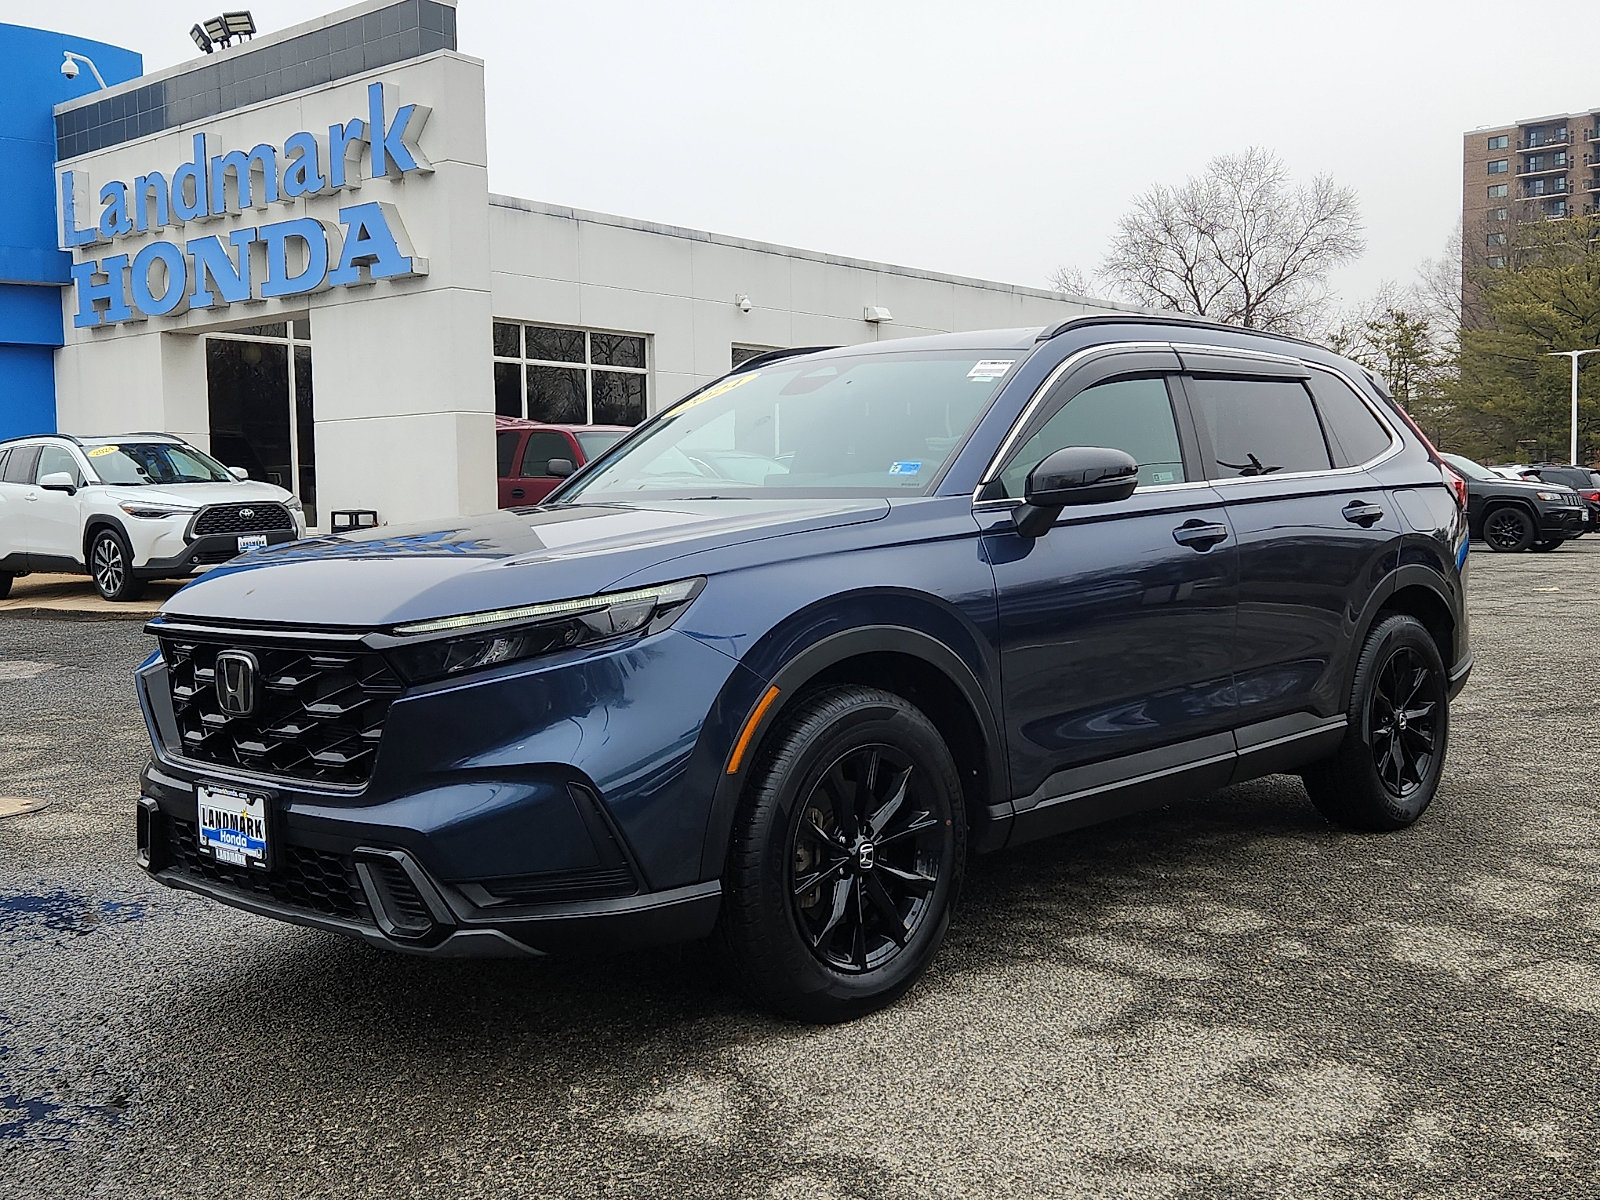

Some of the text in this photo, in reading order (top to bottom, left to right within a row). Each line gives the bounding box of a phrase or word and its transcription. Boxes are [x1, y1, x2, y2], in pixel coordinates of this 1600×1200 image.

[62, 82, 420, 248] Landmark
[71, 202, 414, 328] HONDA
[202, 808, 263, 840] LANDMARK
[220, 830, 247, 848] Honda
